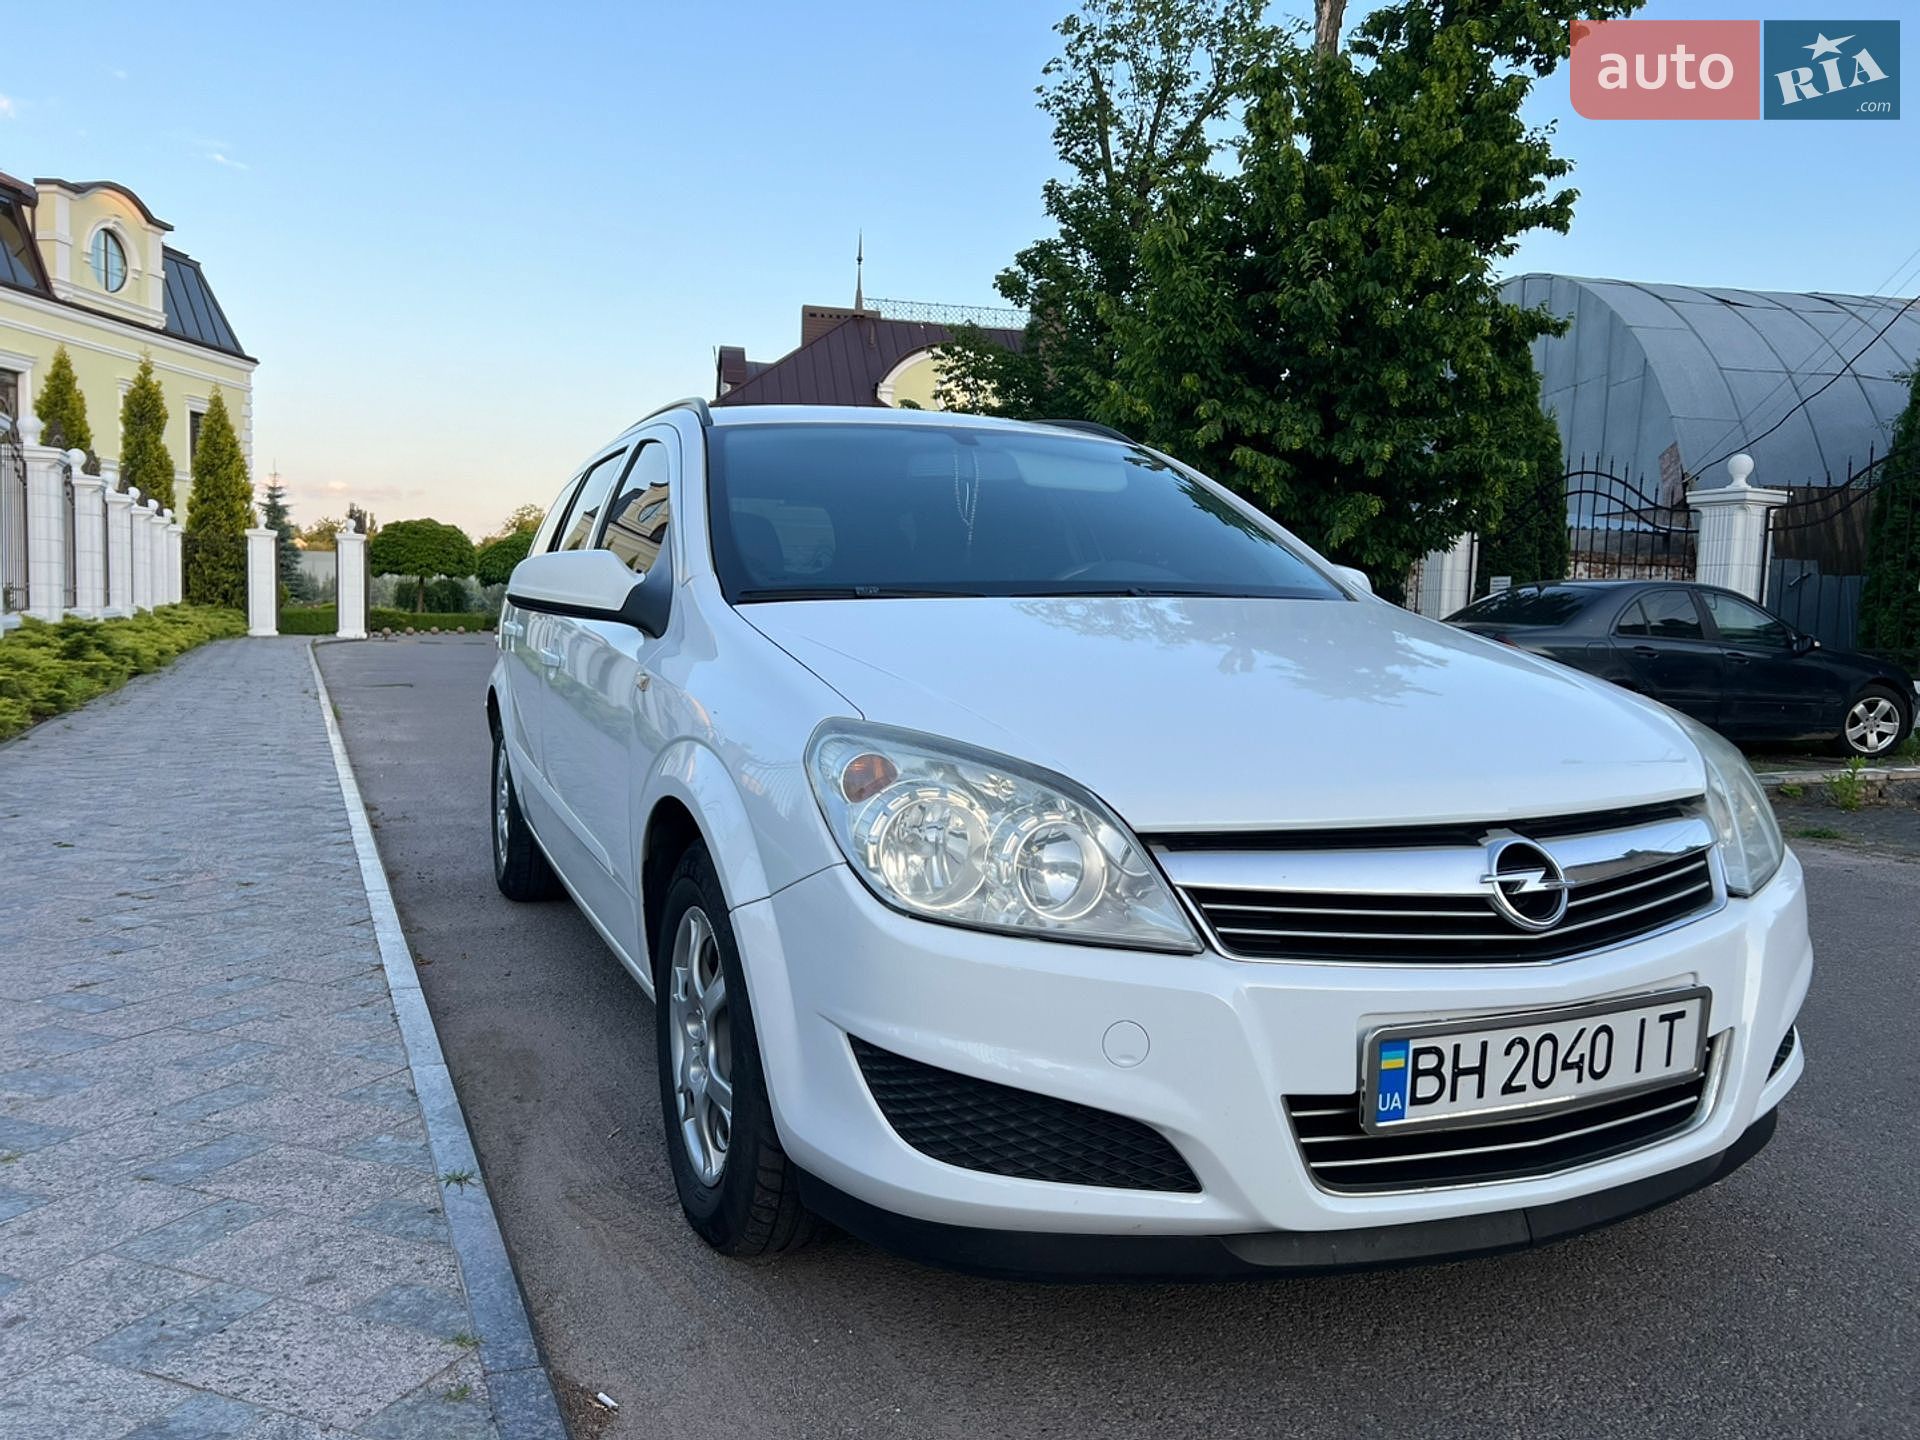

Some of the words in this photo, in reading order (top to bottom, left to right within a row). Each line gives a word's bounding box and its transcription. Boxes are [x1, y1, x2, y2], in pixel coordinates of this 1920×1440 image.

[1409, 1040, 1488, 1106] BH
[1500, 1023, 1614, 1095] 2040
[1635, 1010, 1686, 1073] IT
[1377, 1091, 1402, 1112] UA
